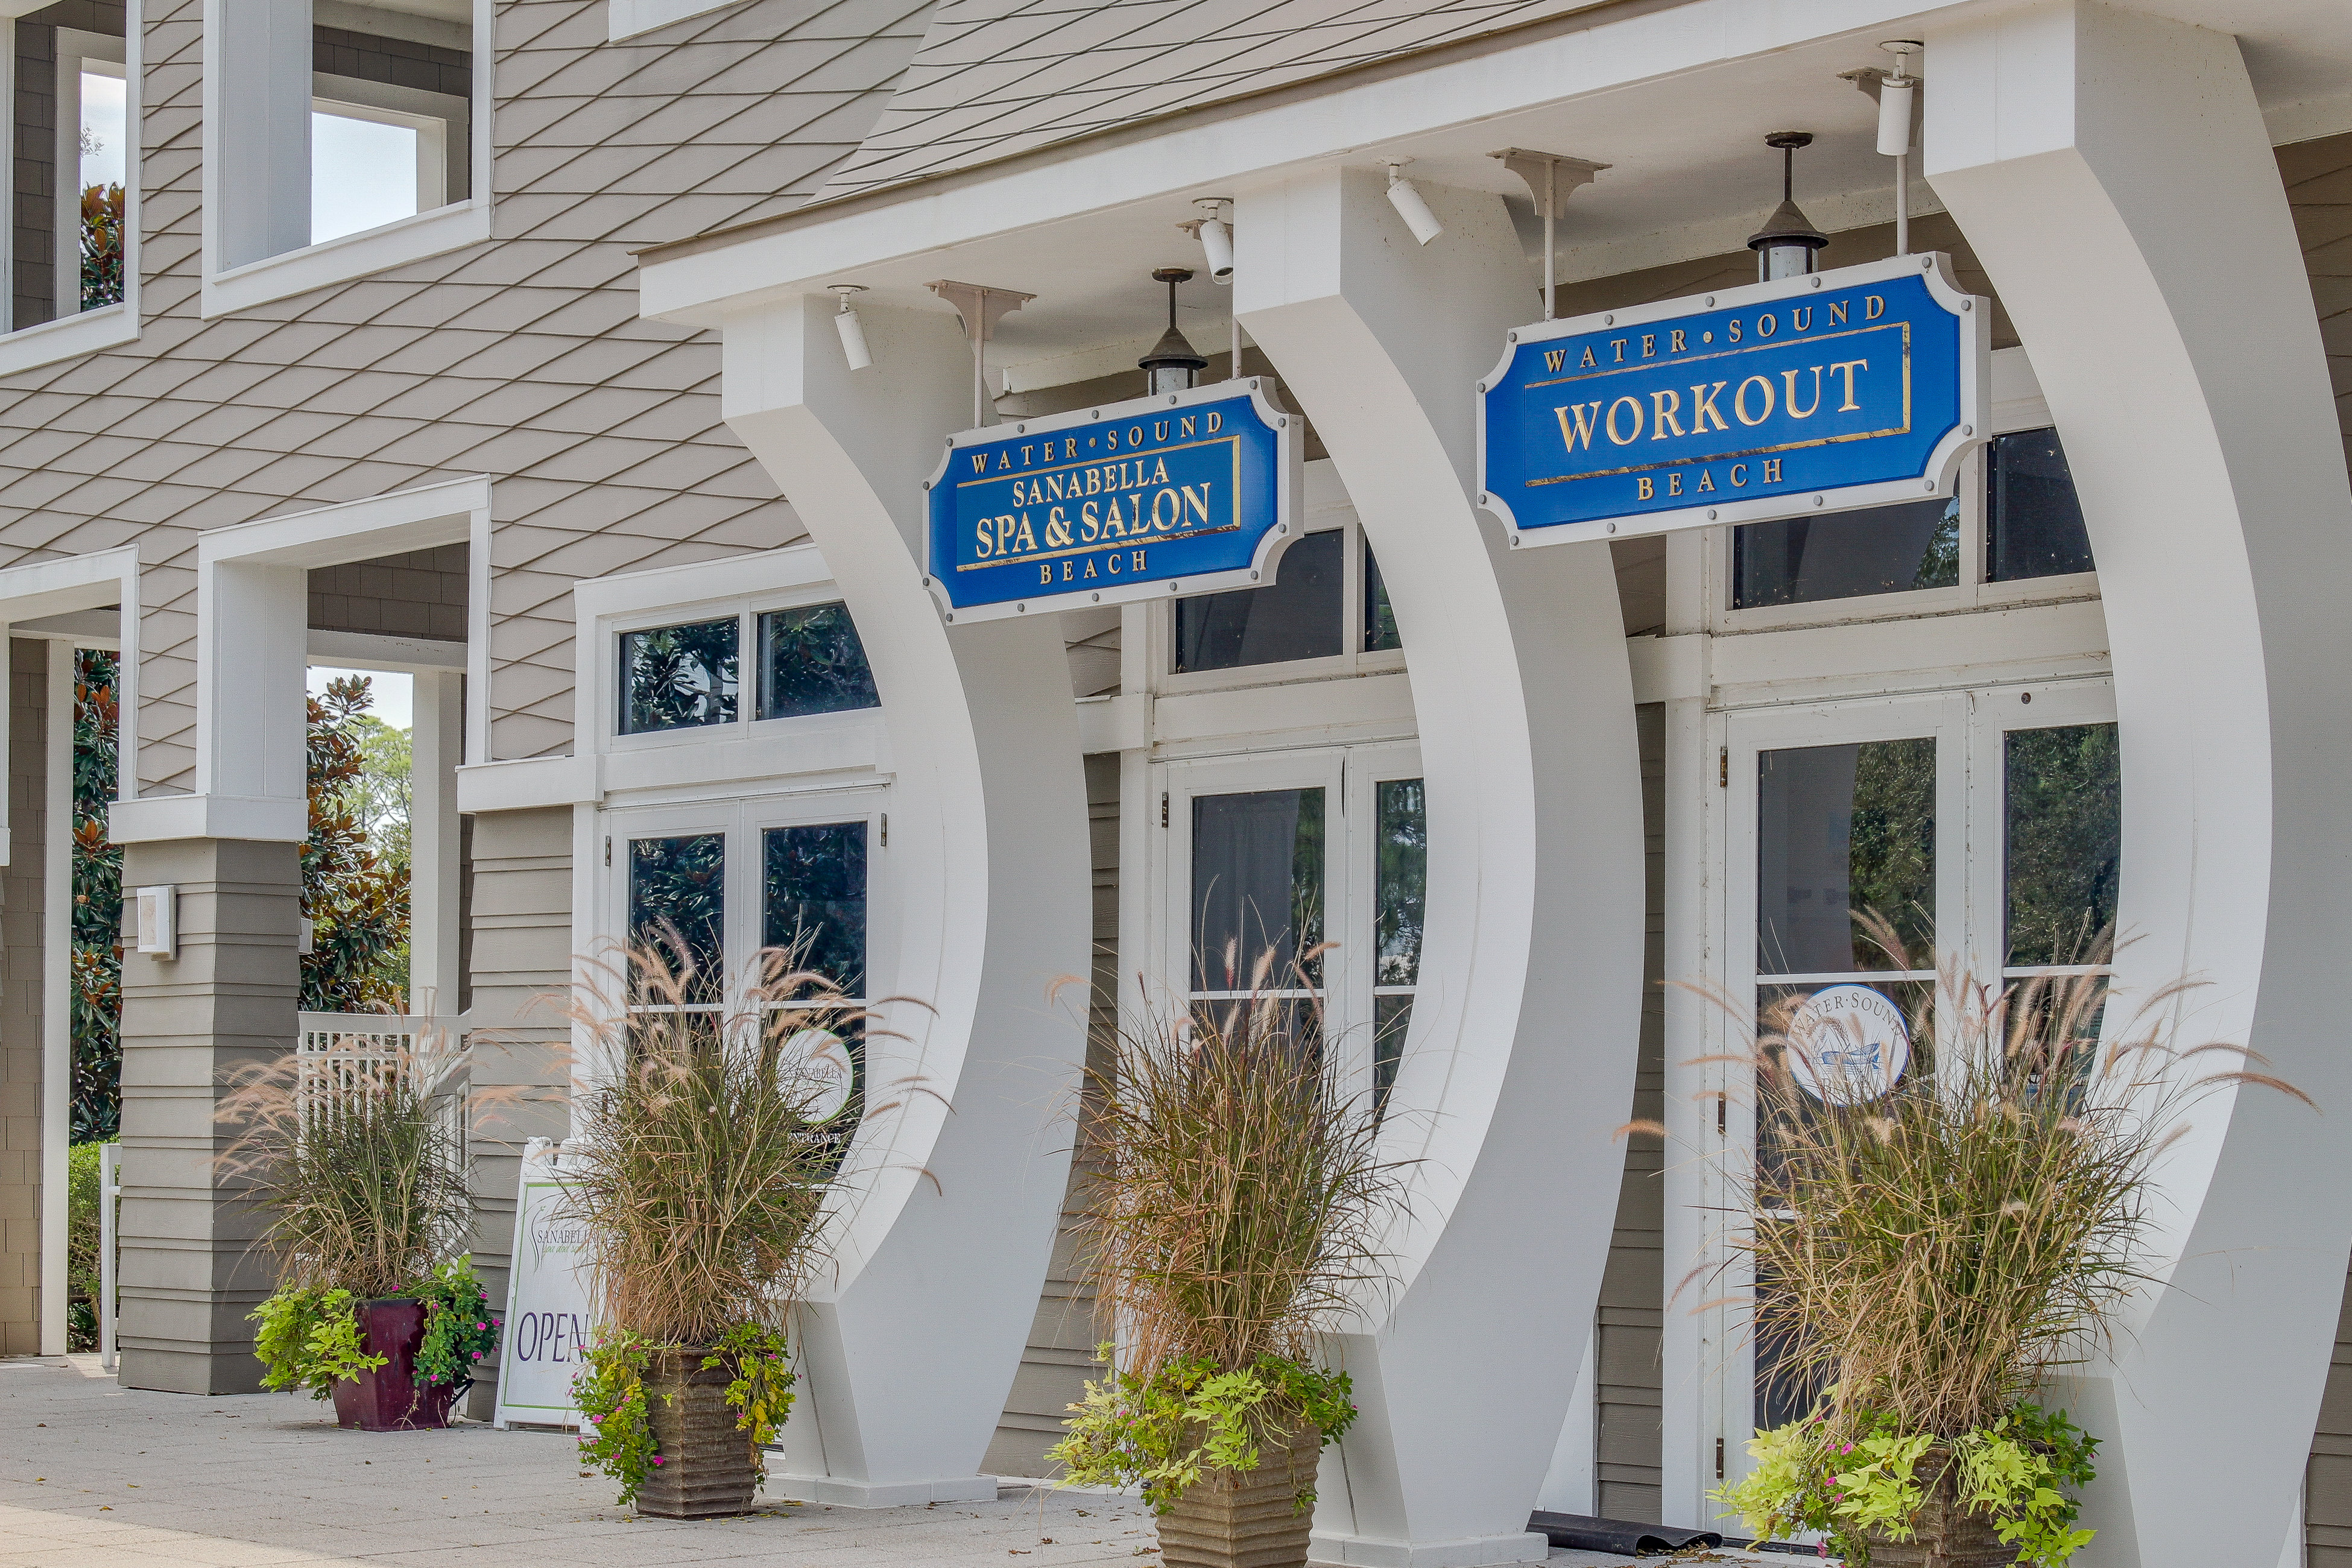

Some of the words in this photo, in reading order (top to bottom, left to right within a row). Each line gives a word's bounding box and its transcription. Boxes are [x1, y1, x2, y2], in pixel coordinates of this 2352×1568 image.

[1554, 359, 1868, 454] WORKOUT
[1013, 457, 1170, 508] SANABELLA
[1637, 458, 1783, 501] BEACH
[976, 512, 1038, 558] SPA
[1045, 507, 1075, 547] &
[1081, 482, 1211, 542] SALON
[1040, 549, 1148, 585] BEACH
[1821, 1078, 1872, 1094] BCH
[787, 1133, 841, 1144] ENTRANCE
[537, 1230, 598, 1244] SANABELL
[517, 1311, 589, 1363] OPEN
